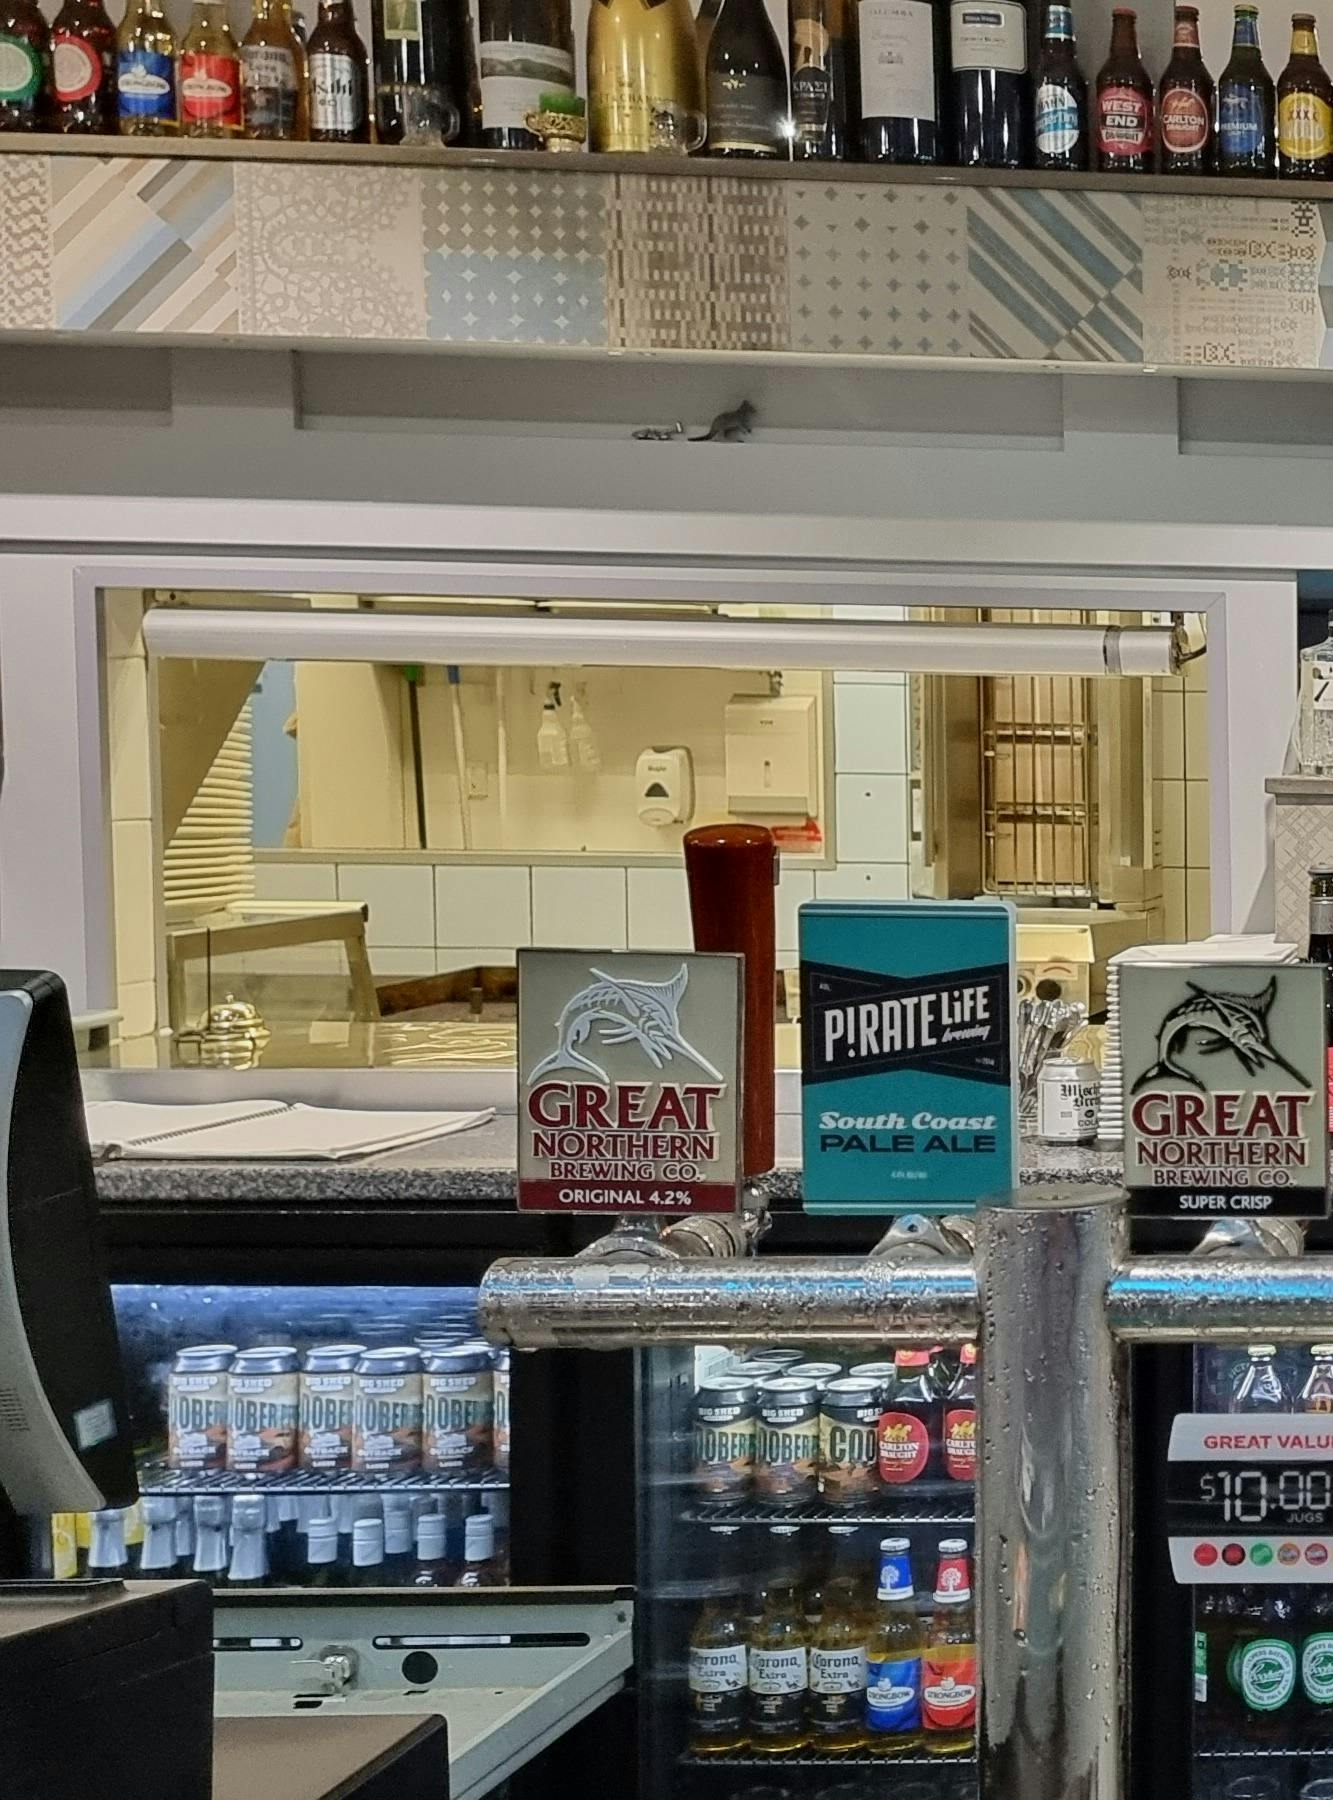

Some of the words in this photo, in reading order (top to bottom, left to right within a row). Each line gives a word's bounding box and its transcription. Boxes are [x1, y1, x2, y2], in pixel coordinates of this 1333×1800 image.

[1102, 100, 1142, 112] WEST
[1106, 115, 1139, 127] END
[1163, 114, 1205, 125] CARLTON
[941, 1024, 992, 1044] brewing
[528, 1081, 728, 1131] GREAT
[1131, 1091, 1316, 1137] GREAT
[818, 1111, 908, 1131] South
[911, 1111, 998, 1131] Coast
[532, 1131, 717, 1162] NORTHERN
[820, 1134, 915, 1153] PALE
[922, 1134, 996, 1153] ALE
[1135, 1138, 1309, 1167] NORTHERN
[549, 1160, 653, 1181] BREWING
[661, 1161, 706, 1182] CO.
[1153, 1167, 1249, 1187] BREWING
[1257, 1167, 1297, 1187] CO.
[558, 1189, 646, 1205] ORIGINAL
[649, 1189, 692, 1206] 4.2%
[1179, 1194, 1227, 1210] SUPER
[1232, 1194, 1274, 1210] CRISP
[778, 1408, 805, 1417] SHED
[1203, 1434, 1272, 1450] GREAT
[1200, 1471, 1331, 1522] $10.00
[1286, 1512, 1325, 1523] JUGS
[753, 1653, 801, 1671] Corona
[812, 1652, 861, 1670] Corona
[758, 1668, 788, 1680] Extra
[820, 1668, 850, 1679] Extra
